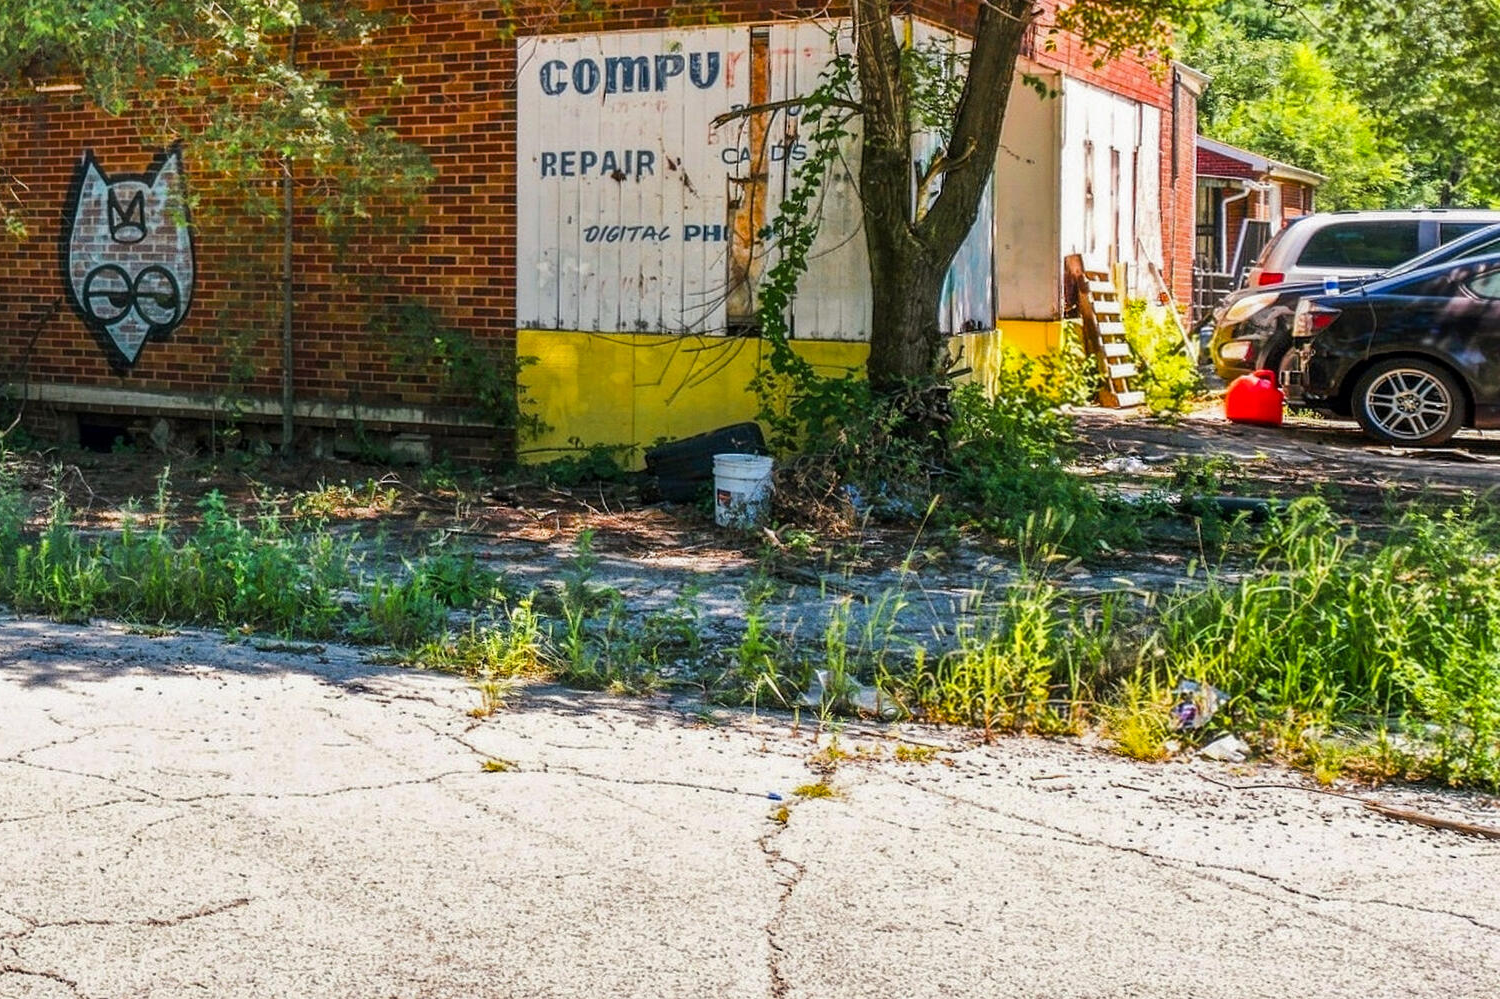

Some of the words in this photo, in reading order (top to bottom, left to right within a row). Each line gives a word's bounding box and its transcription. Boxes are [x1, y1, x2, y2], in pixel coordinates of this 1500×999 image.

[540, 150, 655, 177] REPAIR
[721, 144, 807, 164] CADS
[584, 225, 670, 242] DIGITAL
